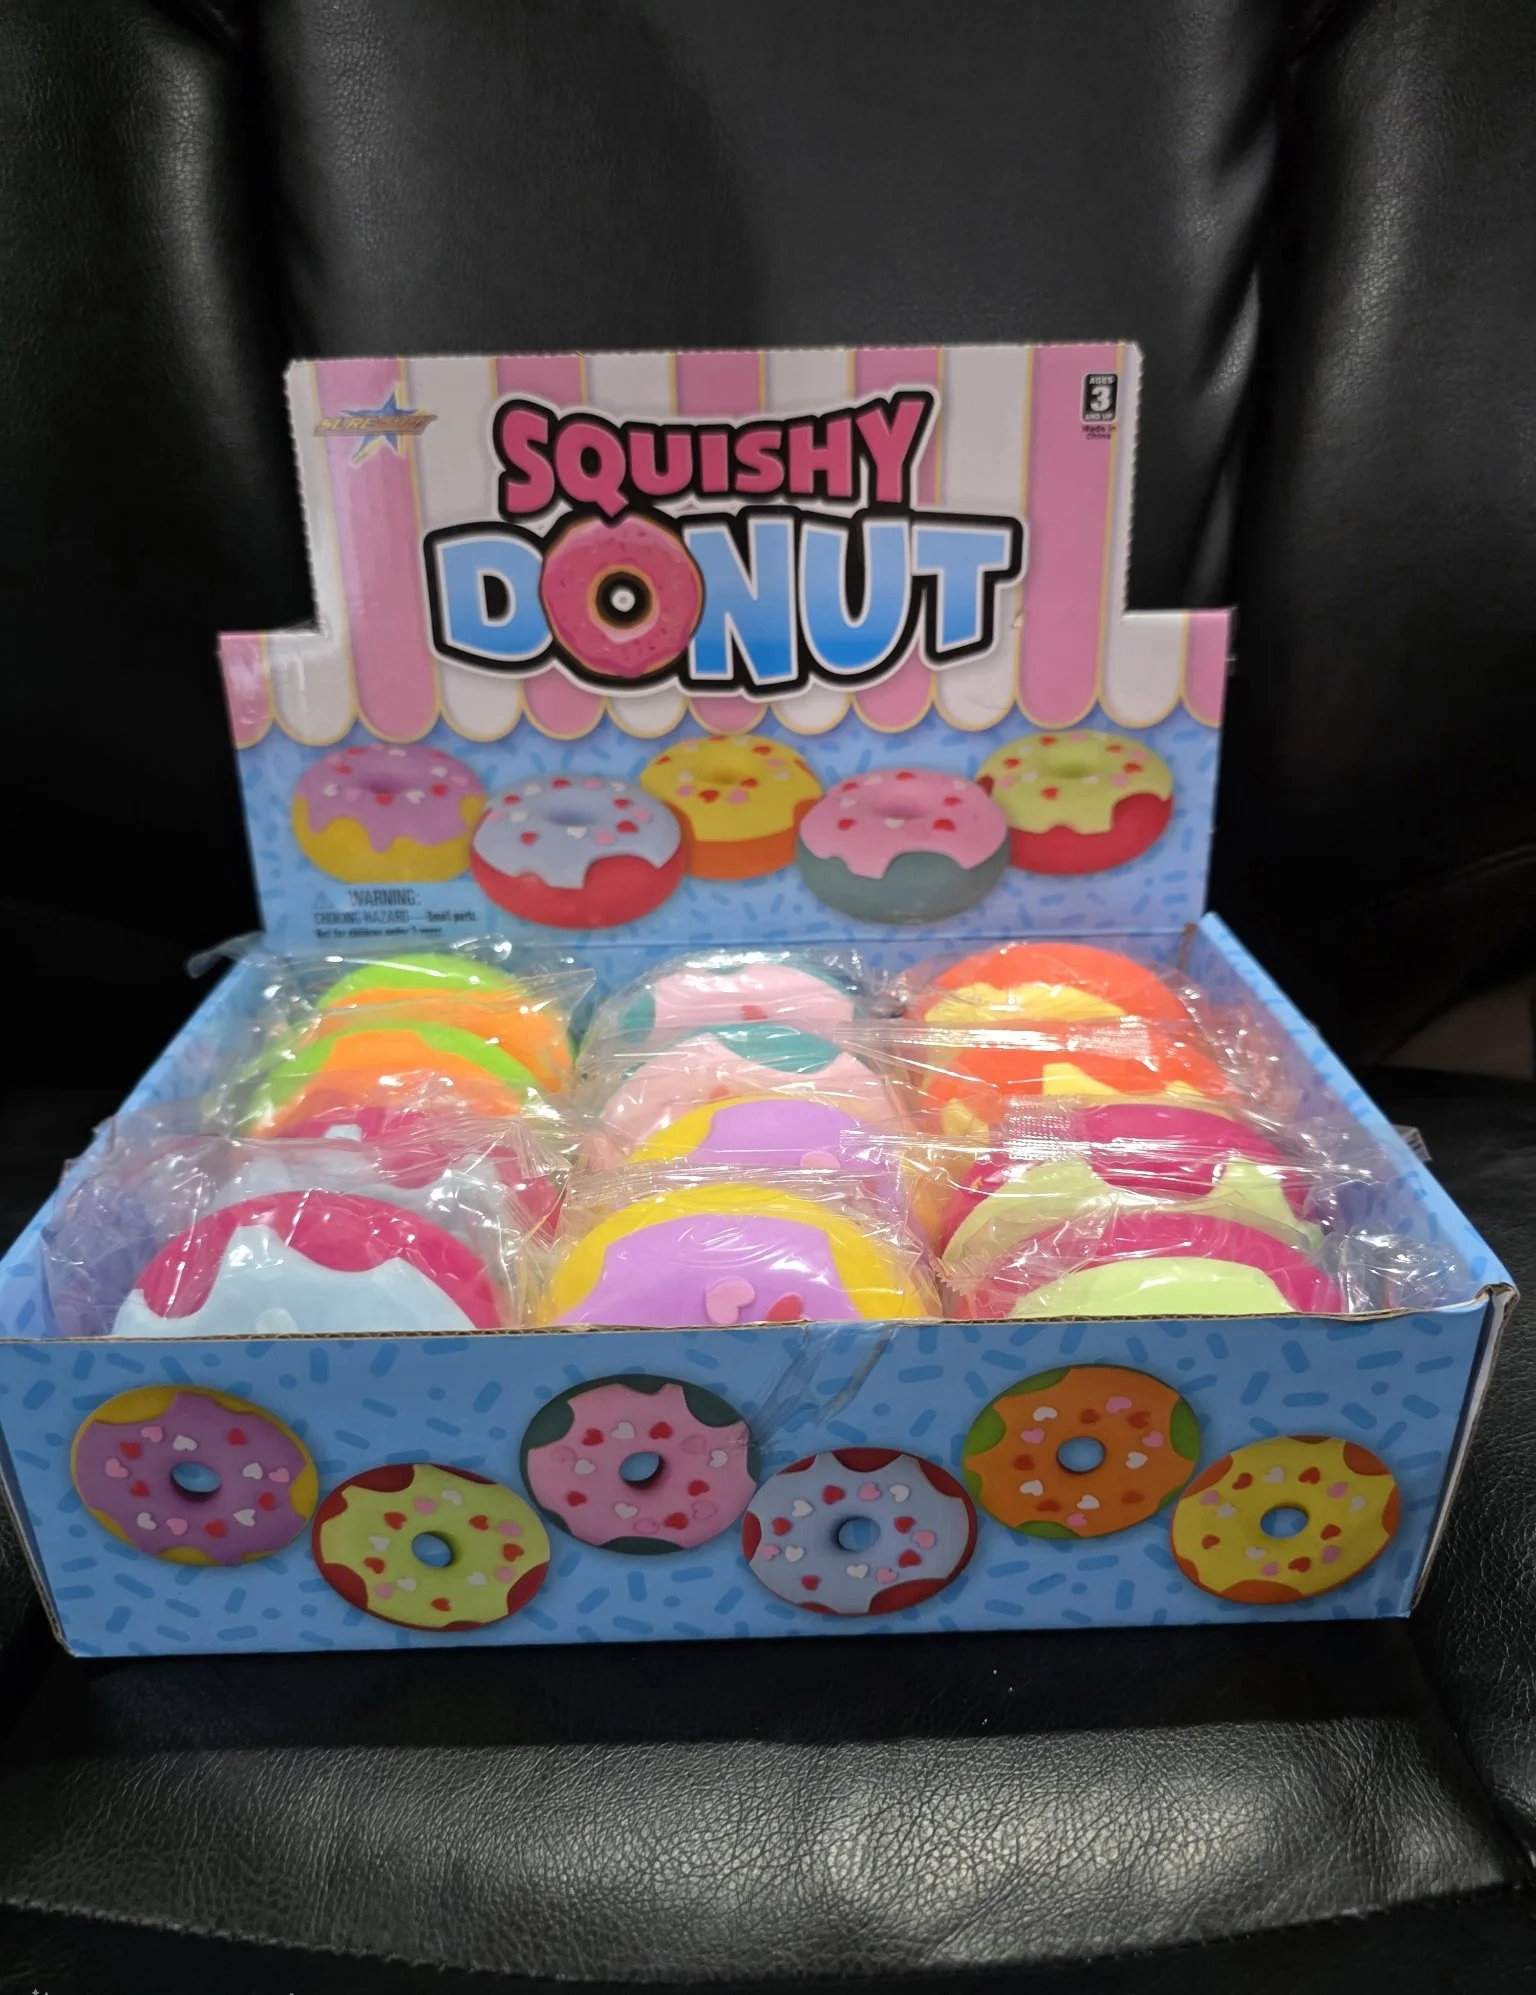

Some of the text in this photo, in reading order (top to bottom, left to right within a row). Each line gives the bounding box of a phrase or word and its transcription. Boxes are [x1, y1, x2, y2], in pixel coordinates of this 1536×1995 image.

[1090, 385, 1112, 412] 3
[496, 396, 931, 519] SQUISHY
[428, 508, 1018, 690] DONUT
[349, 887, 422, 907] WARNING:
